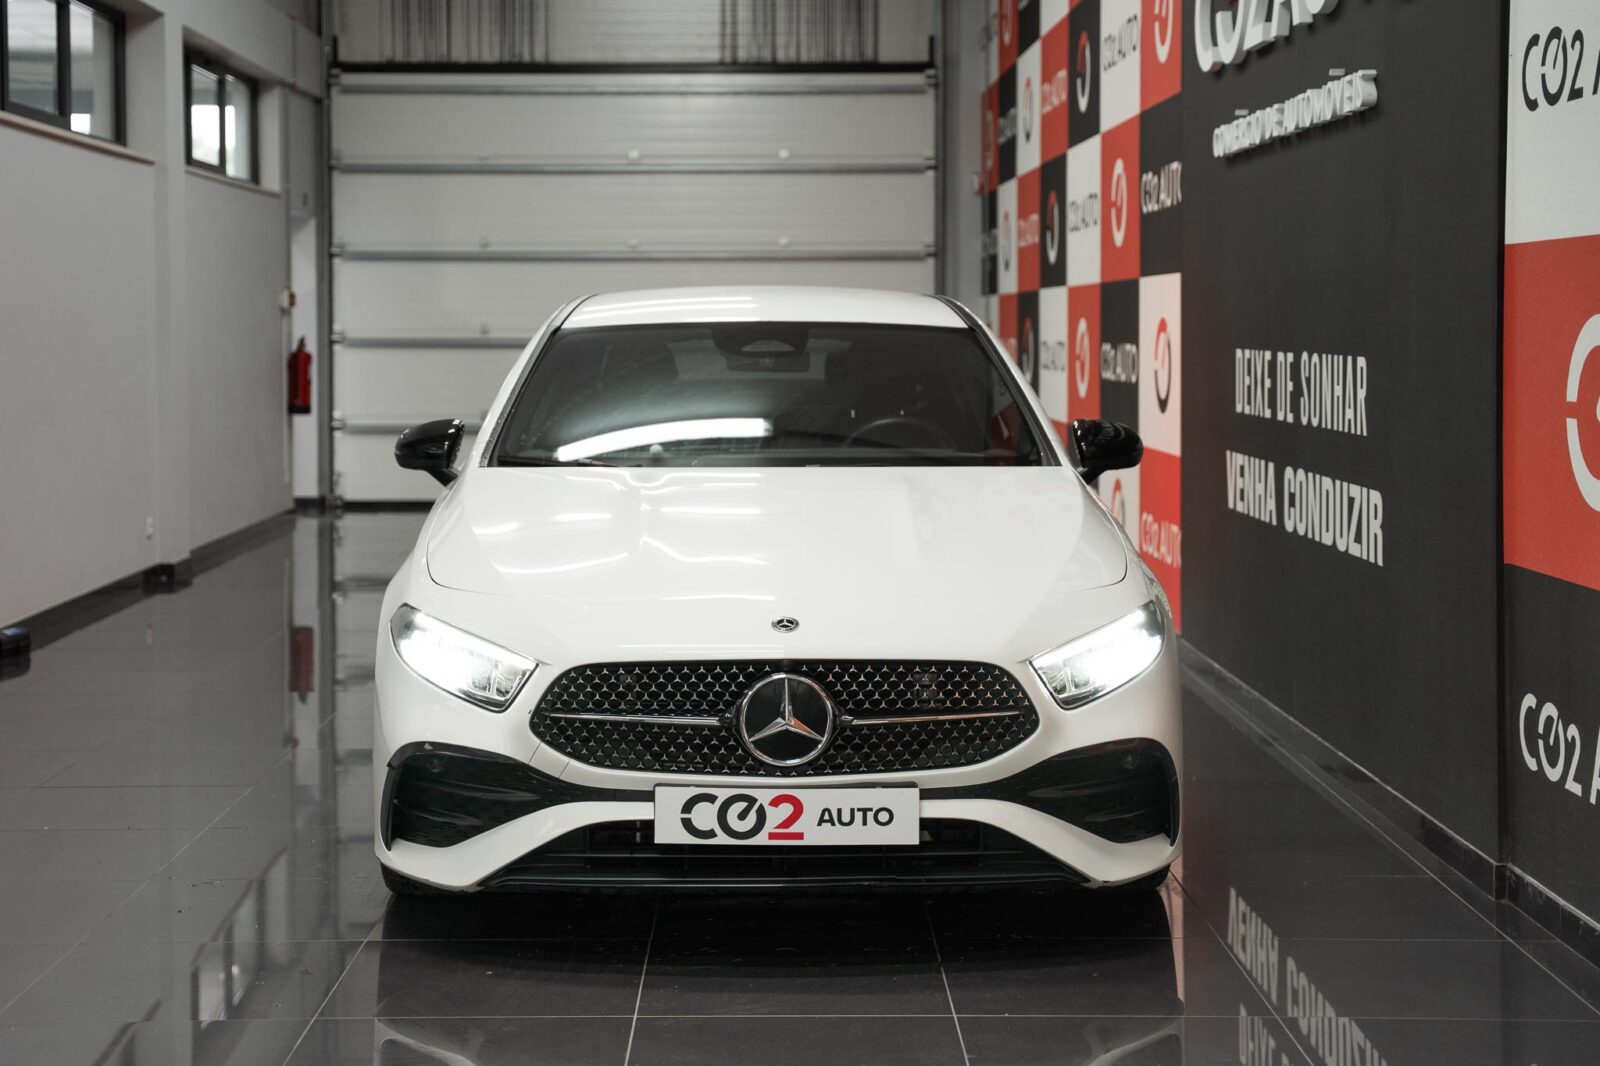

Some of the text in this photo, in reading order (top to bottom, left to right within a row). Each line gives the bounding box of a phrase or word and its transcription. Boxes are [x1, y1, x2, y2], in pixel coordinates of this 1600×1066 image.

[1522, 26, 1584, 112] CO2
[1235, 348, 1367, 436] DEIXE DE SONHAR
[1225, 450, 1383, 567] VENHA CONDUZIR
[1519, 693, 1582, 797] CO2
[680, 792, 894, 840] CO2 AUTO
